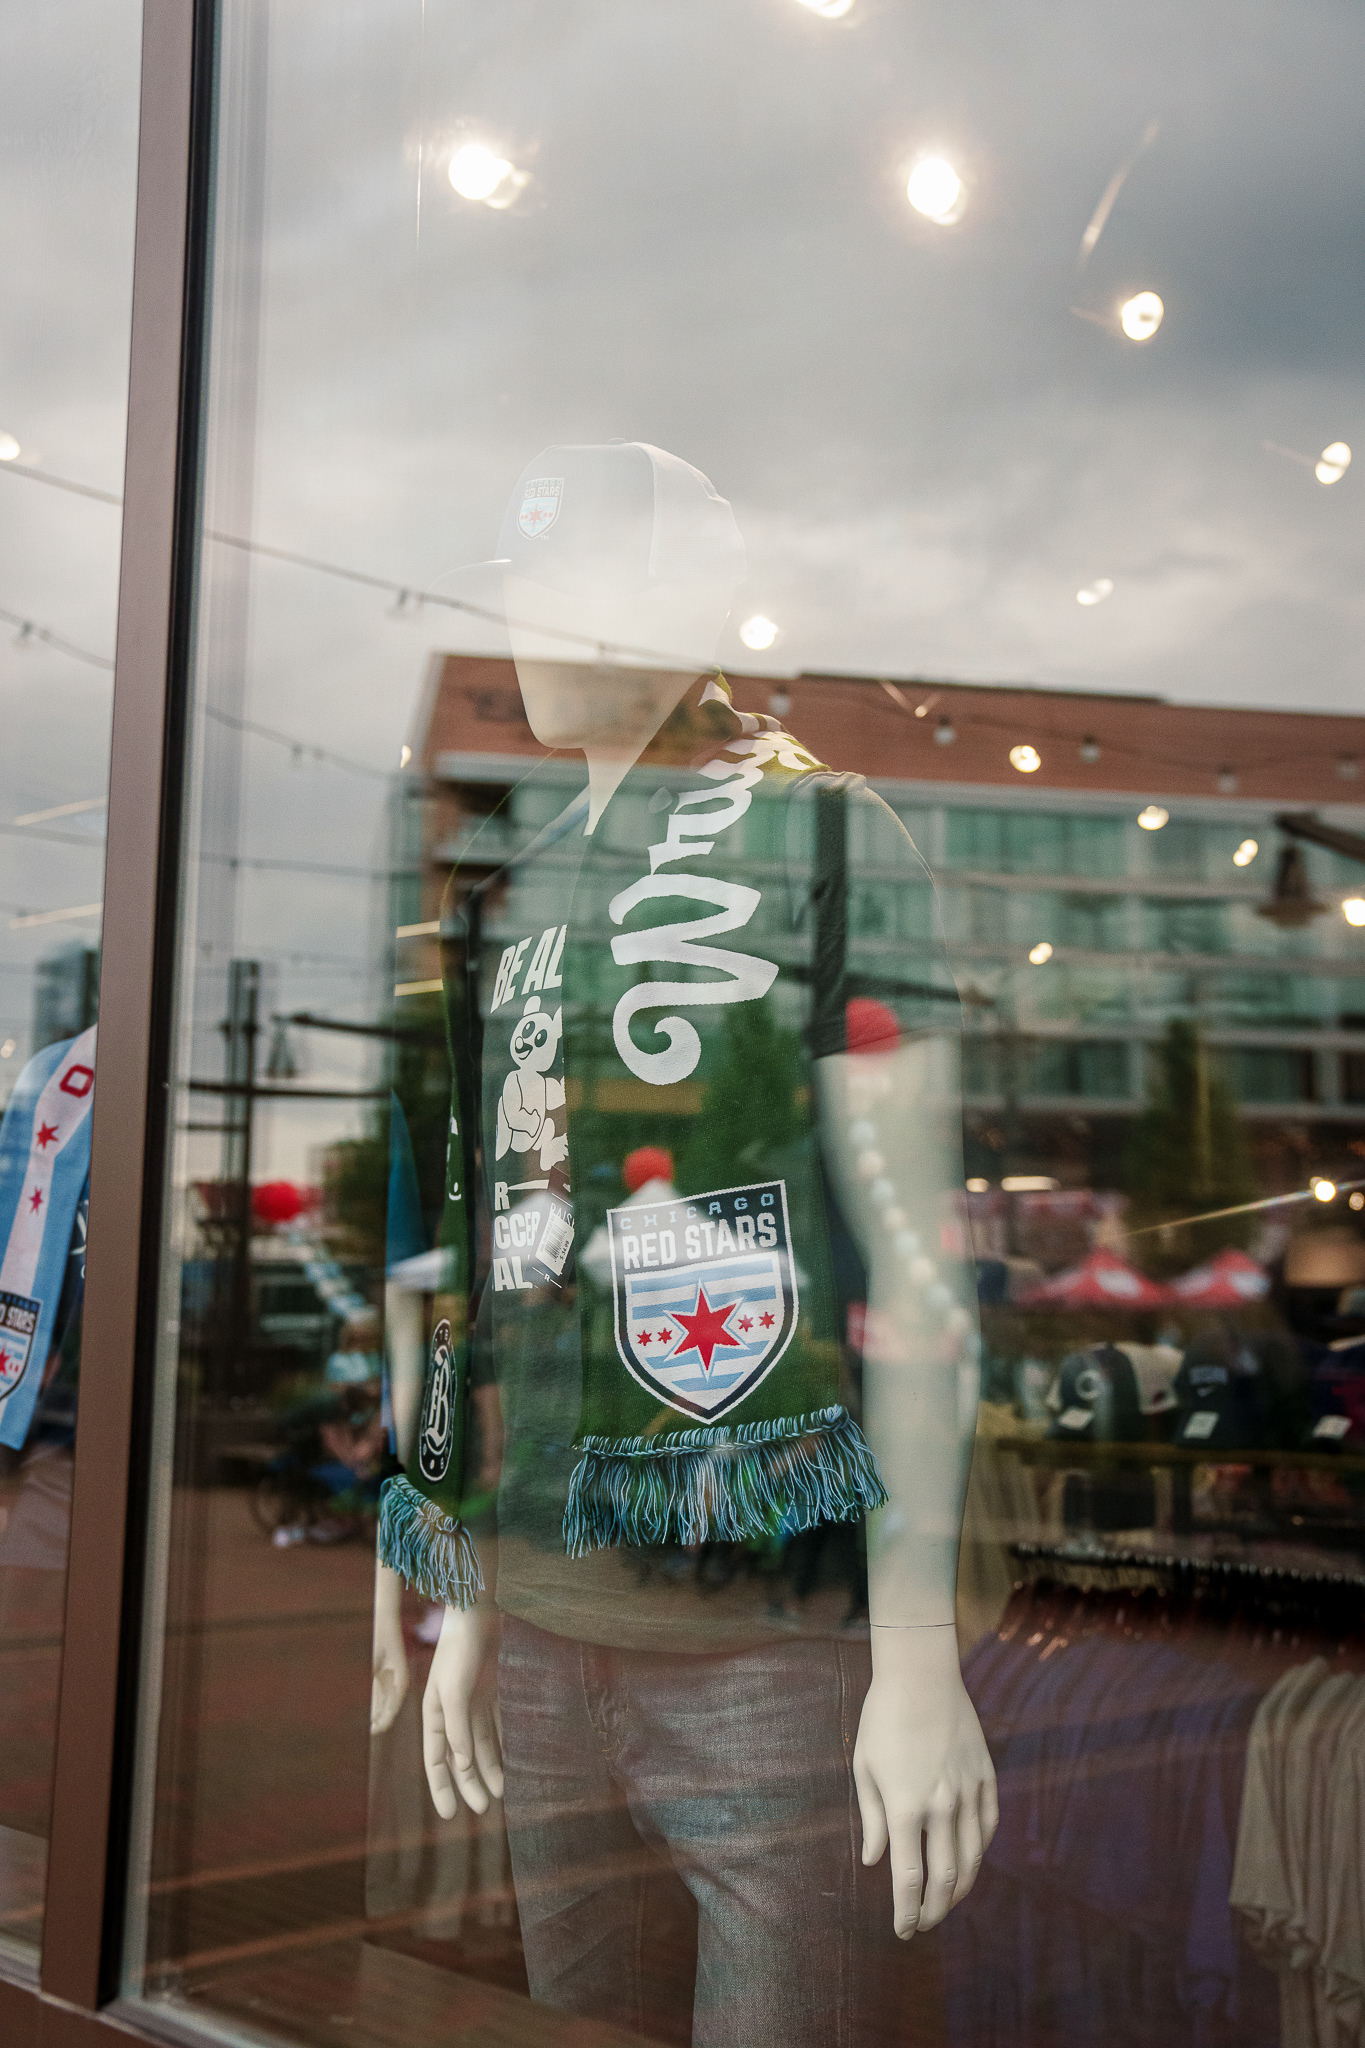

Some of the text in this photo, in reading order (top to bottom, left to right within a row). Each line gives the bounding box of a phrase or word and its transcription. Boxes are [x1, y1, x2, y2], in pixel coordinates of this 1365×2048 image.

[537, 486, 560, 497] STARS
[490, 936, 533, 1014] BE
[494, 1181, 511, 1211] R
[620, 1193, 775, 1230] CHICAGO
[493, 1211, 541, 1250] CCER
[622, 1212, 778, 1270] RED STARS
[493, 1255, 534, 1292] AL
